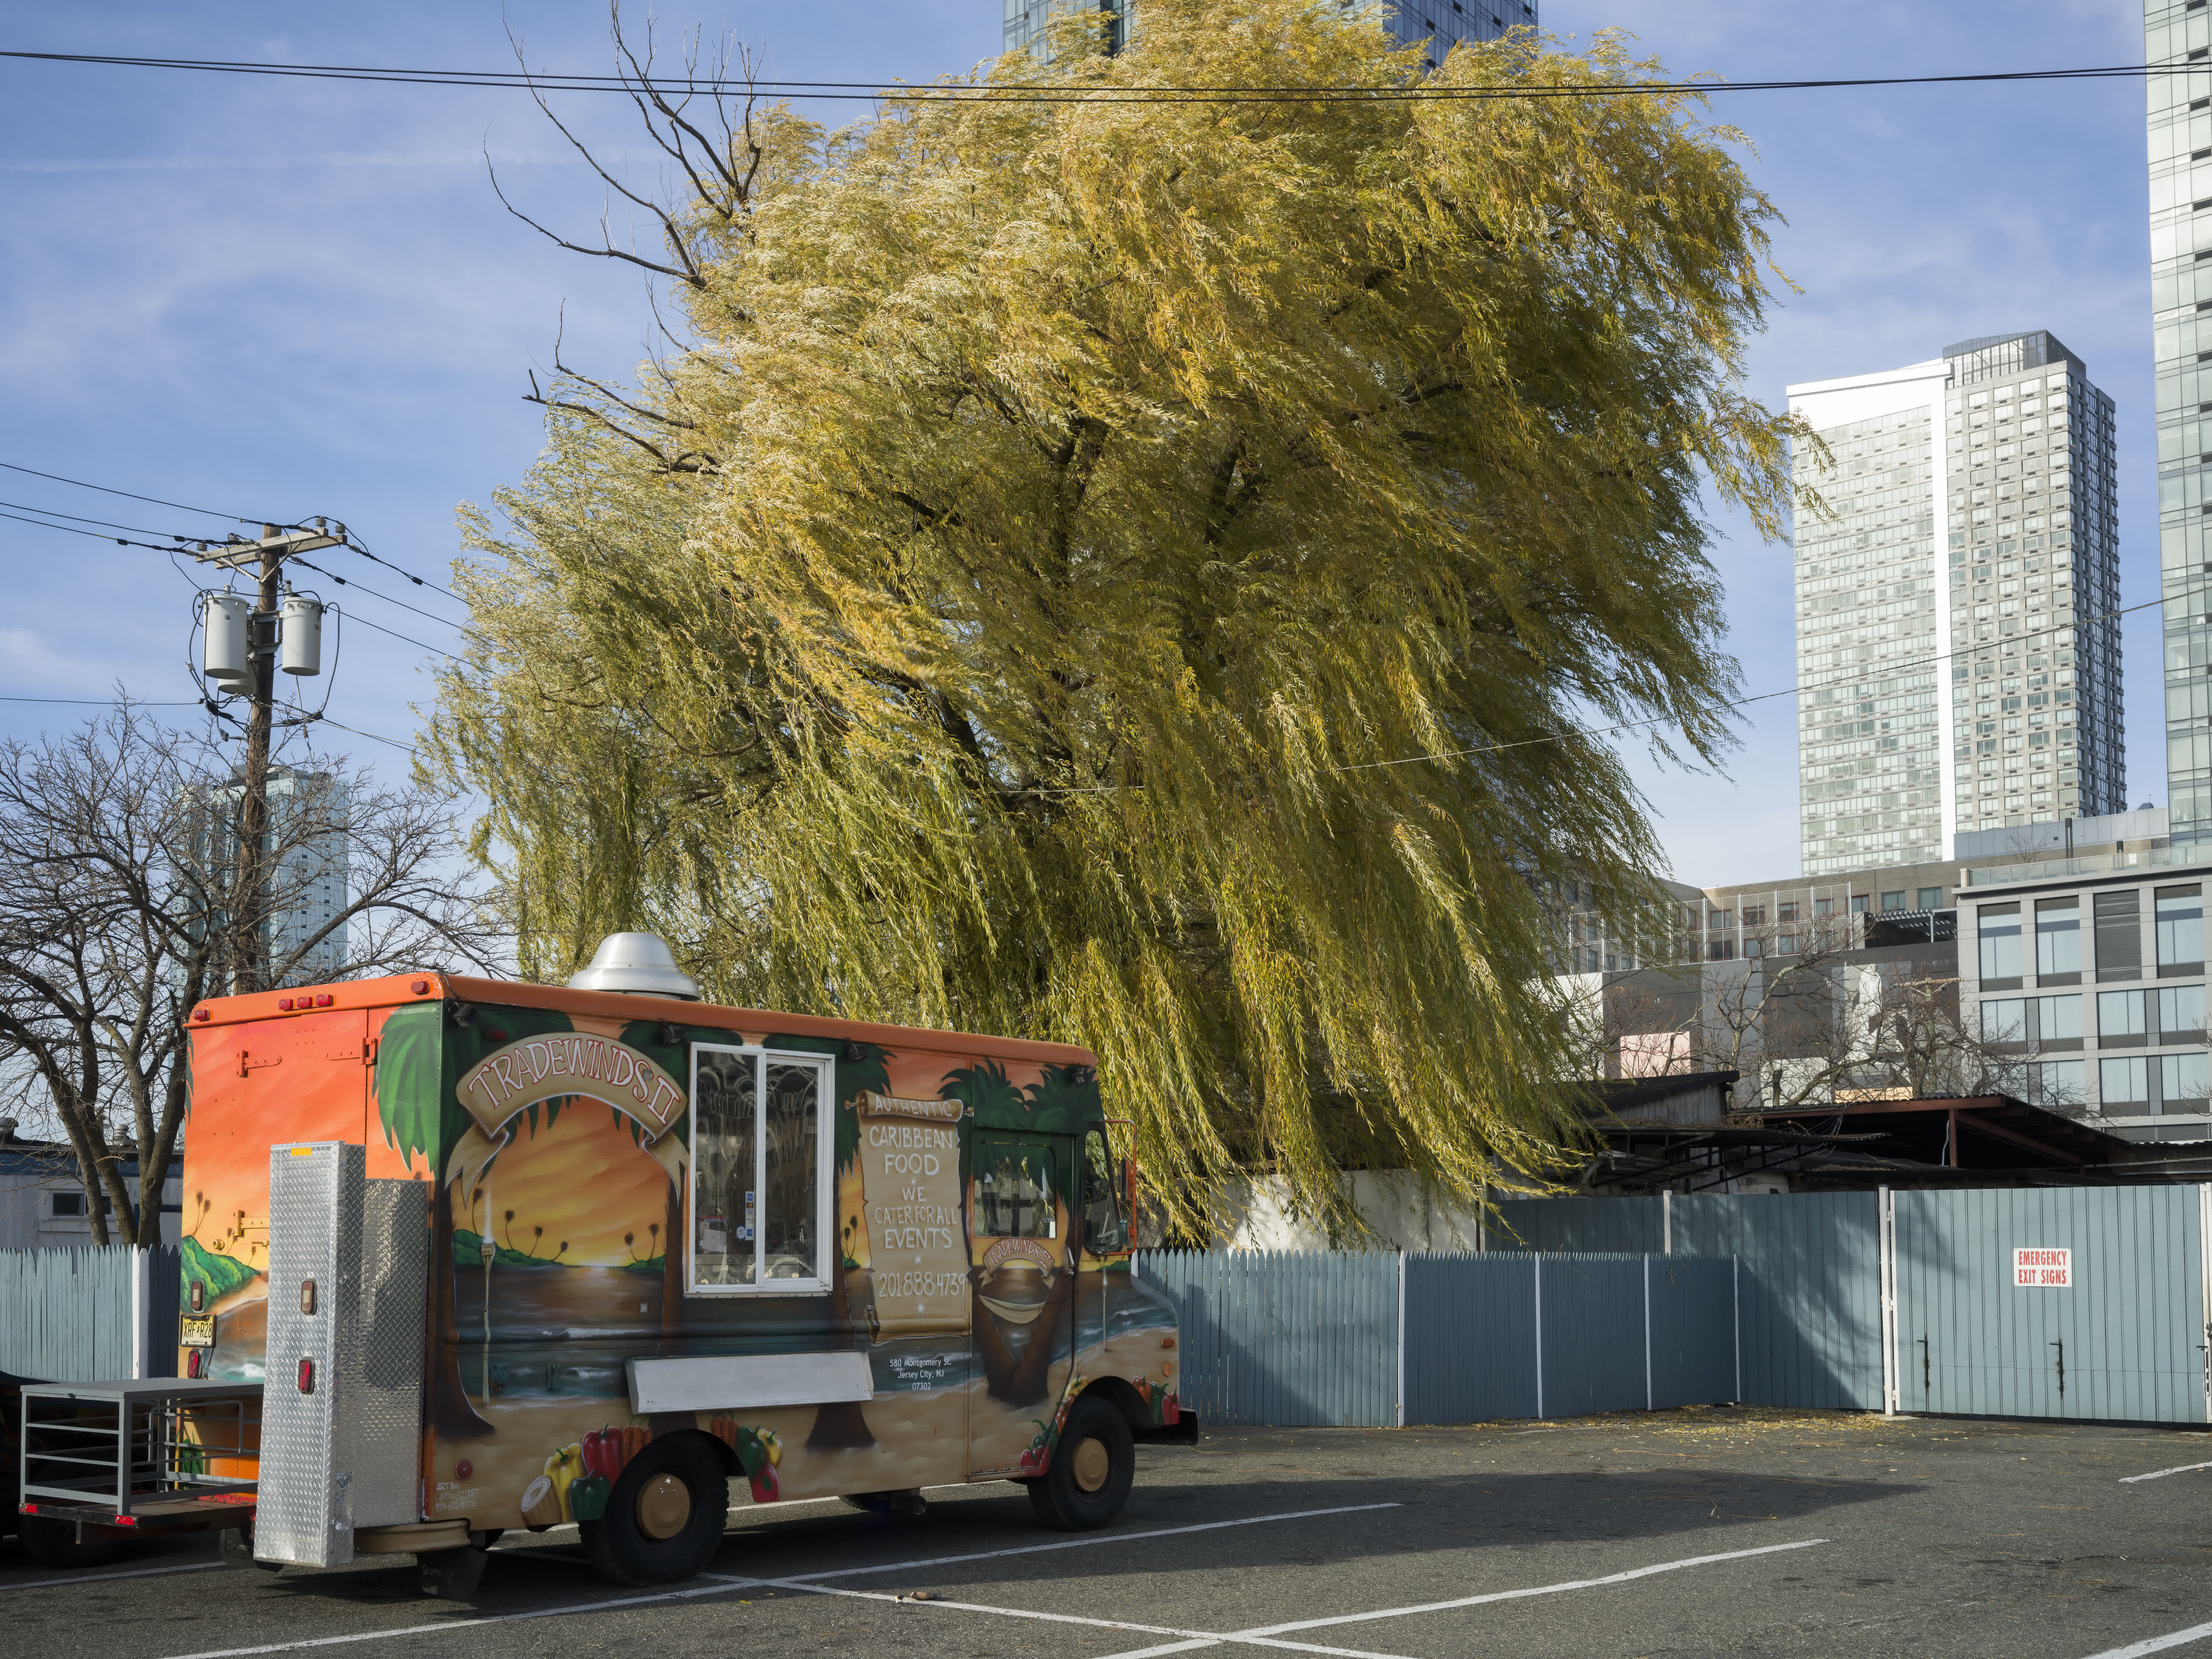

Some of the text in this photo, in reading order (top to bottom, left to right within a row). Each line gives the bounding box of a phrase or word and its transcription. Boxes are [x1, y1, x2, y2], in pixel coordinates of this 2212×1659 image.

[467, 1038, 681, 1126] TRADEWINDS II
[875, 1095, 952, 1117] AUTHENTIC
[869, 1125, 953, 1149] CARIBBEAN
[884, 1153, 940, 1176] FOOD
[902, 1186, 926, 1202] WE
[874, 1206, 958, 1225] CATER FOR ALL
[884, 1227, 952, 1249] EVENTS
[985, 1238, 1052, 1270] TRADEWINDS II
[2018, 1251, 2067, 1266] EMERGENCY
[2018, 1269, 2067, 1284] EXIT SIGNS
[183, 1322, 212, 1338] XRF R28
[890, 1357, 952, 1368] 580 Montgomery St.
[897, 1371, 918, 1380] Jersey
[920, 1370, 934, 1379] City,
[912, 1382, 931, 1390] 07302
[437, 1482, 449, 1490] ART
